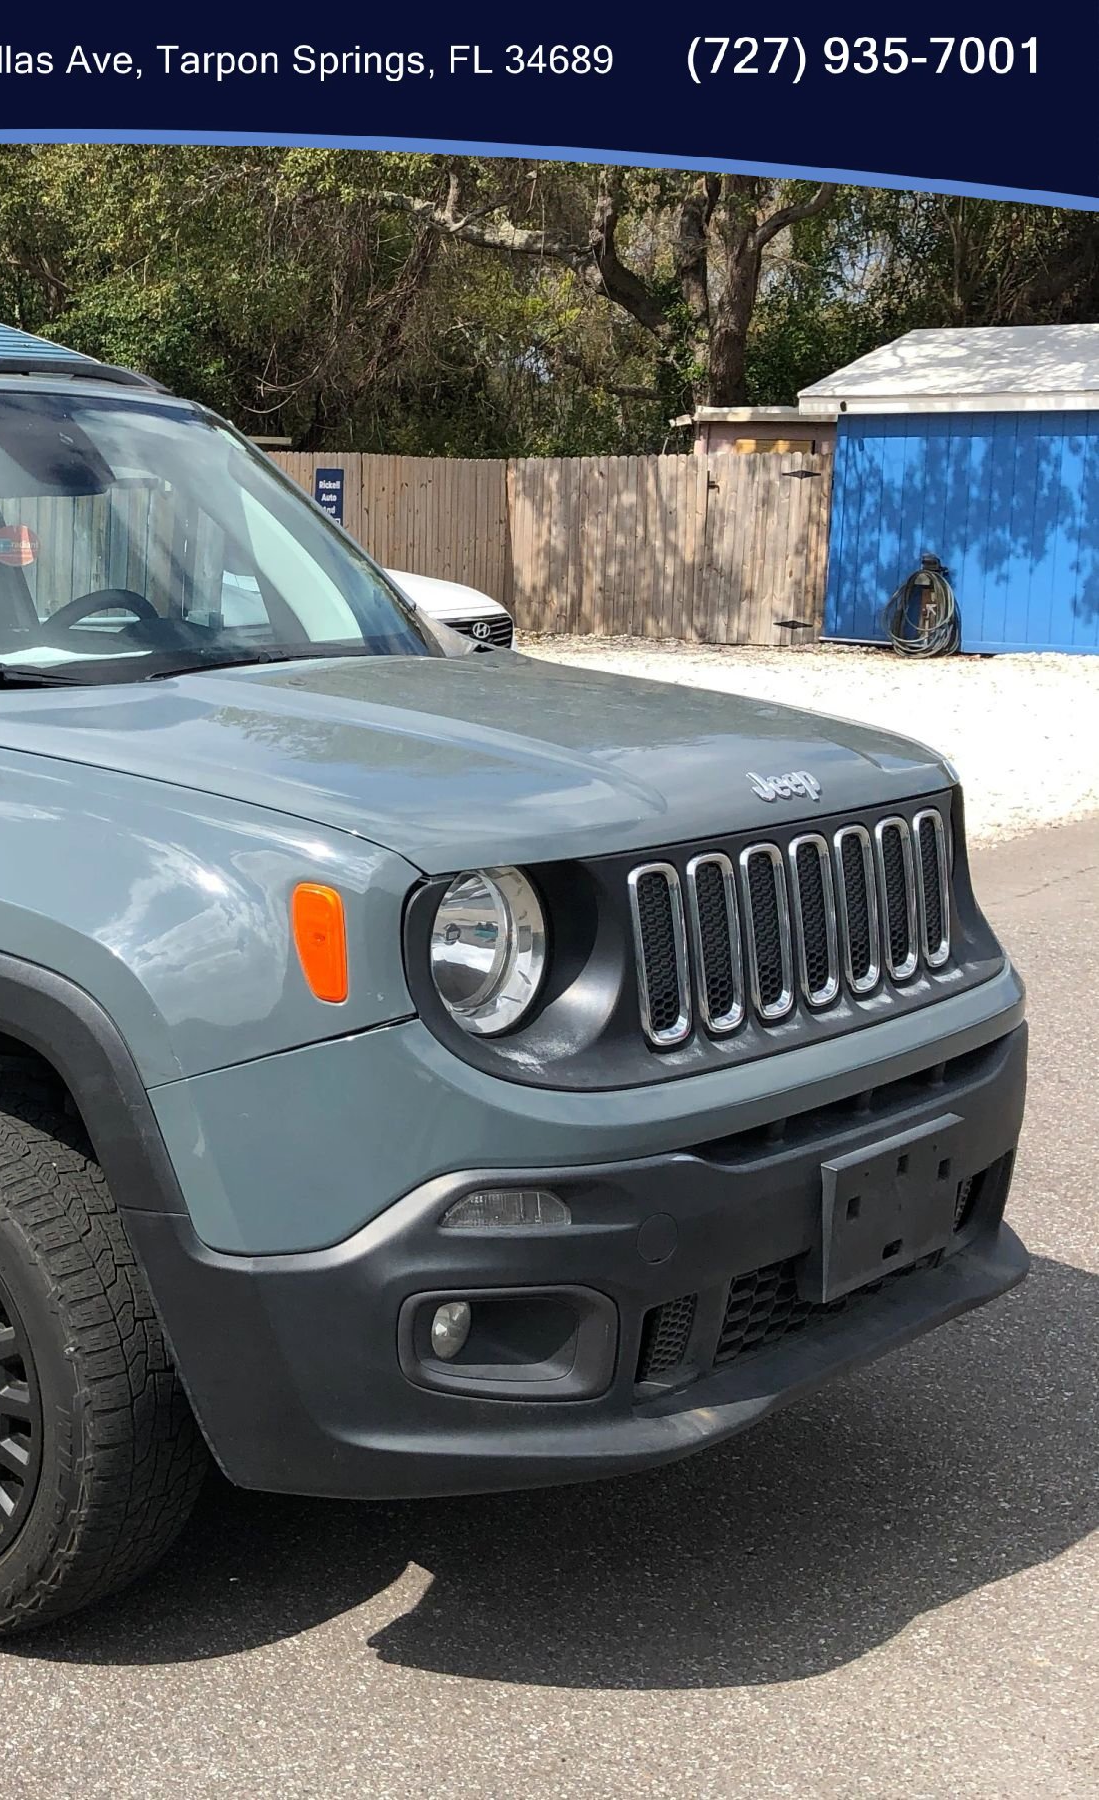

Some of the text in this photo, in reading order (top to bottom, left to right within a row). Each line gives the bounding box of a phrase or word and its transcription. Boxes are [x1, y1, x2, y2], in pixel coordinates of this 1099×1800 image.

[318, 480, 341, 489] Rickell
[321, 493, 337, 502] Auto
[745, 770, 822, 802] Jeep
